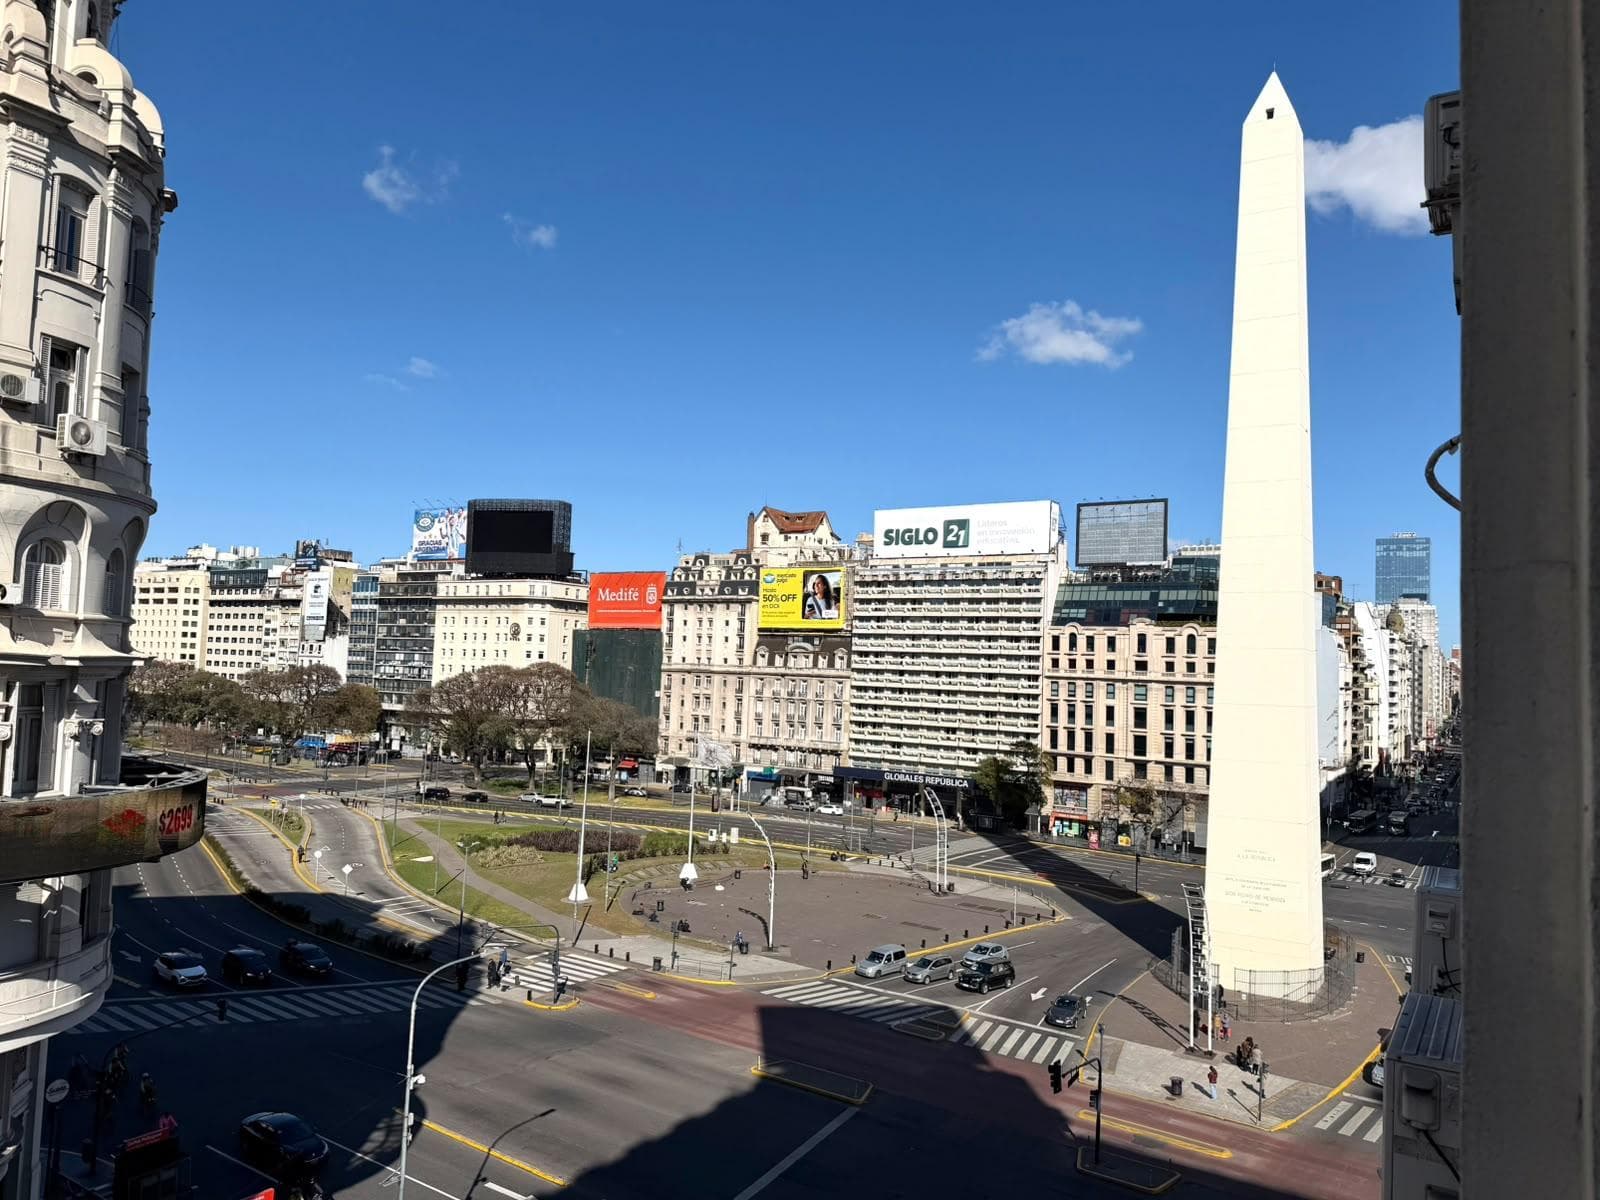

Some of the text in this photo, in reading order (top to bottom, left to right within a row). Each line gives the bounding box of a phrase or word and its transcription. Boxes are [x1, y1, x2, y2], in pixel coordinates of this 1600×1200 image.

[883, 524, 966, 547] SIGLO 21
[597, 587, 640, 601] Medifé
[762, 593, 798, 603] 50% OFF
[884, 772, 924, 784] GLOBALES
[159, 804, 193, 835] $2699
